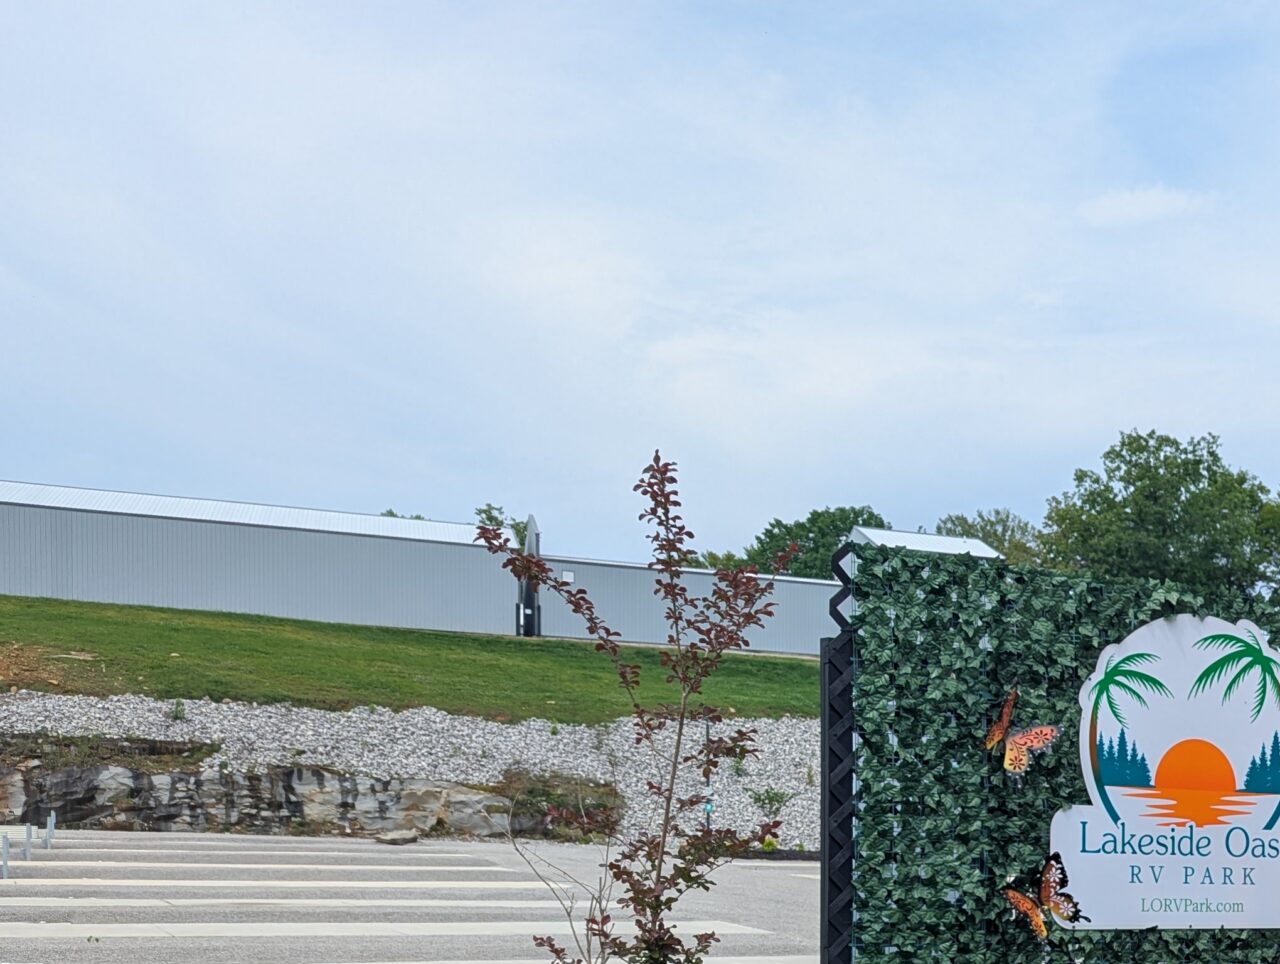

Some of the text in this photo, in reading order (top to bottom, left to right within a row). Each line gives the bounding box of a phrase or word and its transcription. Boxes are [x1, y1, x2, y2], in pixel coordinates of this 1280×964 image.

[1079, 820, 1212, 857] Lakeside
[1128, 864, 1256, 886] RV PARK
[1140, 897, 1244, 914] LORVPark.com
